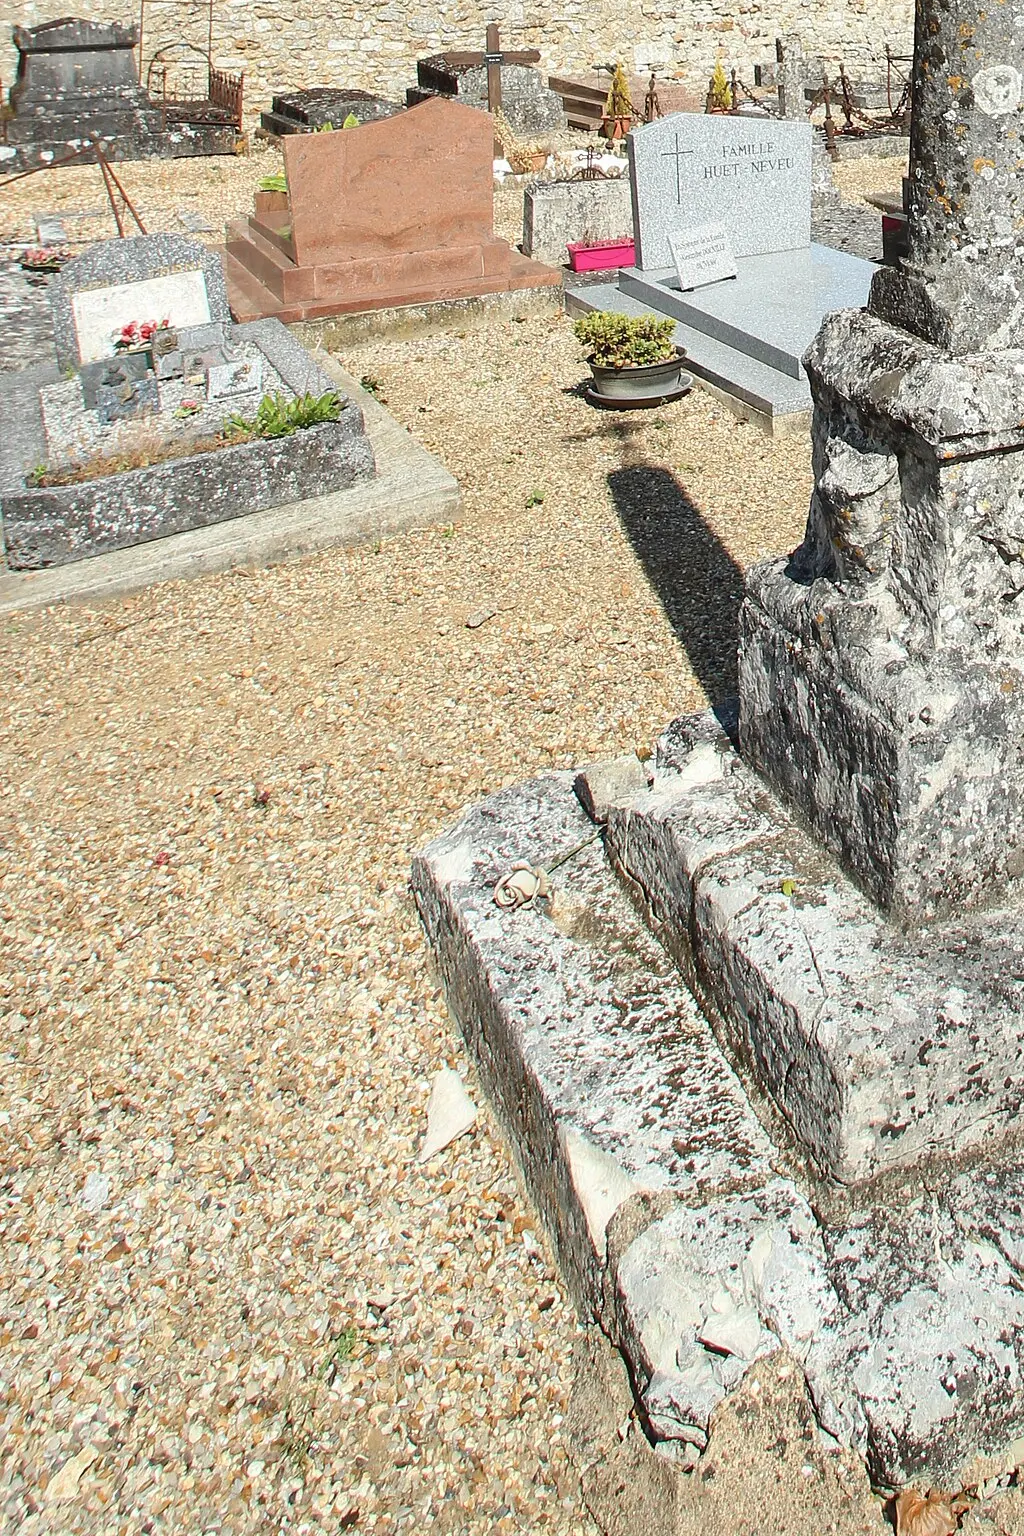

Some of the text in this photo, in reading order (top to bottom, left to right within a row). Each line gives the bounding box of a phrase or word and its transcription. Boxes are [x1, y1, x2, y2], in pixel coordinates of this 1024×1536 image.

[722, 141, 775, 157] FAMILLE
[703, 163, 740, 179] HUET
[751, 157, 794, 173] NEVEU
